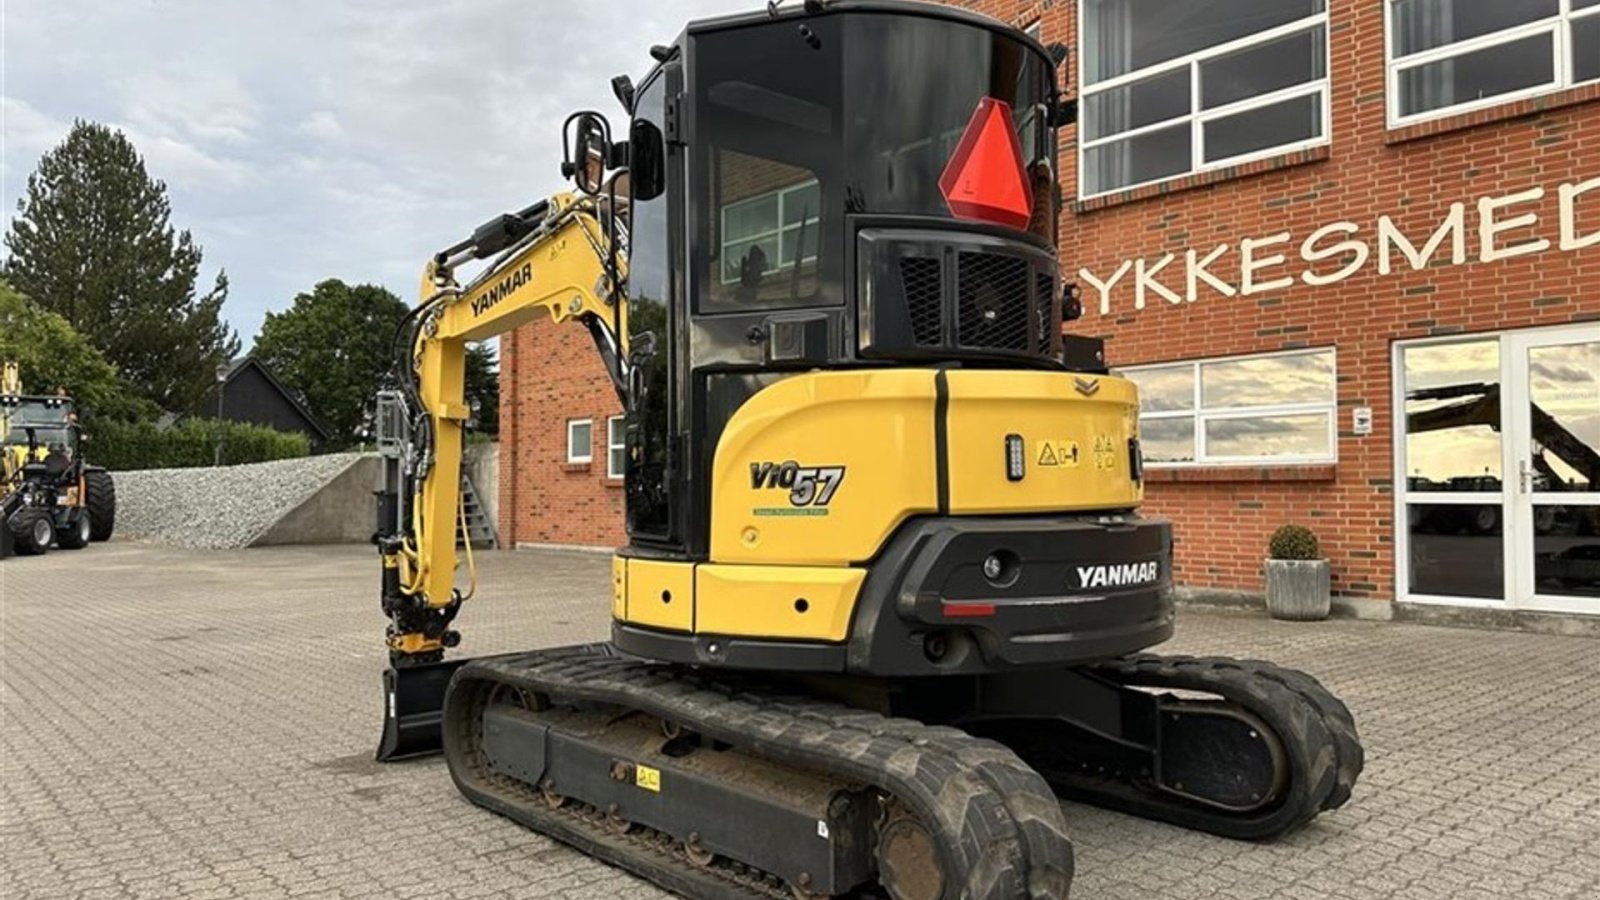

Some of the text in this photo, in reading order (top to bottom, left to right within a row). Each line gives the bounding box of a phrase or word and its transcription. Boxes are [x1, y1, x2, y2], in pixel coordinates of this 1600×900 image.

[1080, 177, 1600, 315] YKKESMED
[471, 263, 532, 317] YANMAR
[1077, 562, 1158, 588] YANMAR
